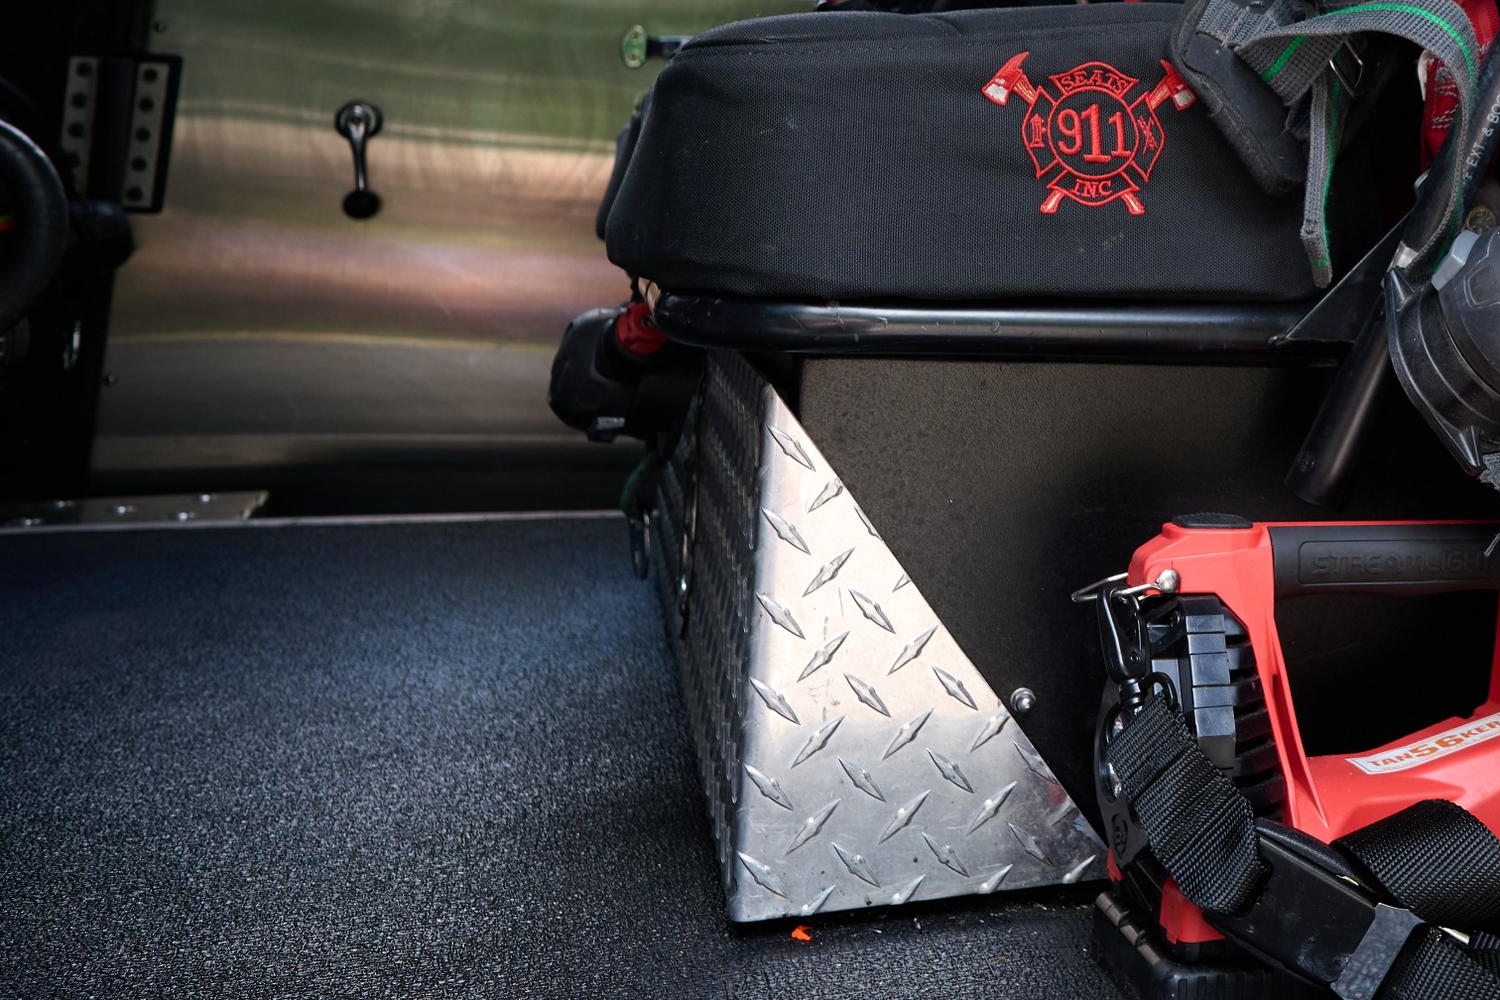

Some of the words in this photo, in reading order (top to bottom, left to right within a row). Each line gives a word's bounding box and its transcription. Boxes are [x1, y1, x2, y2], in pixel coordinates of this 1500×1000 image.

[1060, 70, 1129, 96] SEATS
[1057, 103, 1132, 164] 911
[1482, 127, 1495, 137] &
[1071, 179, 1113, 198] INC
